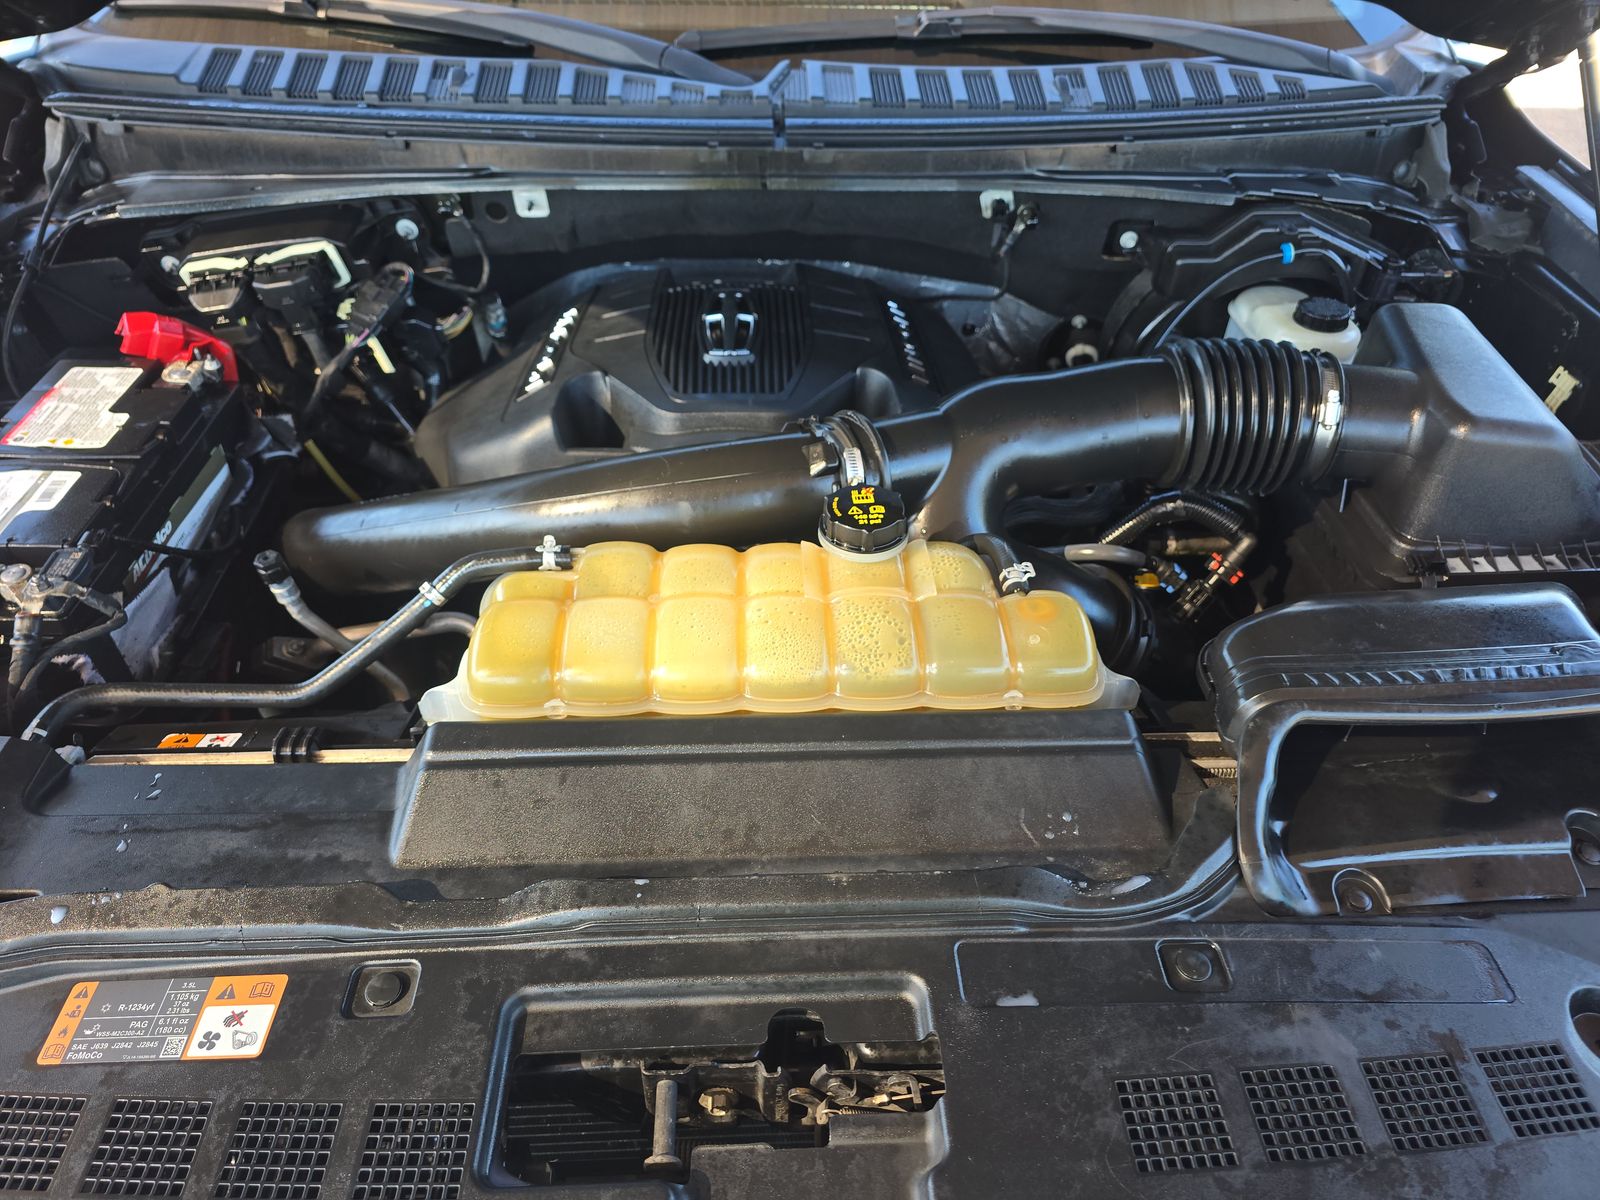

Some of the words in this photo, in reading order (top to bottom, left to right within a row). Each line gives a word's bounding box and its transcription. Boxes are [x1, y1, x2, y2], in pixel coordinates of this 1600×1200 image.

[170, 992, 189, 1001] 1.105
[190, 992, 200, 1003] kg
[118, 1002, 156, 1012] R-1234yf
[129, 1020, 149, 1029] PAG
[171, 1017, 178, 1025] fl
[155, 1027, 173, 1035] (180
[173, 1026, 187, 1034] cc)
[90, 1042, 109, 1050] J639
[137, 1040, 160, 1048] J2845
[66, 1051, 103, 1060] FoMoCo
